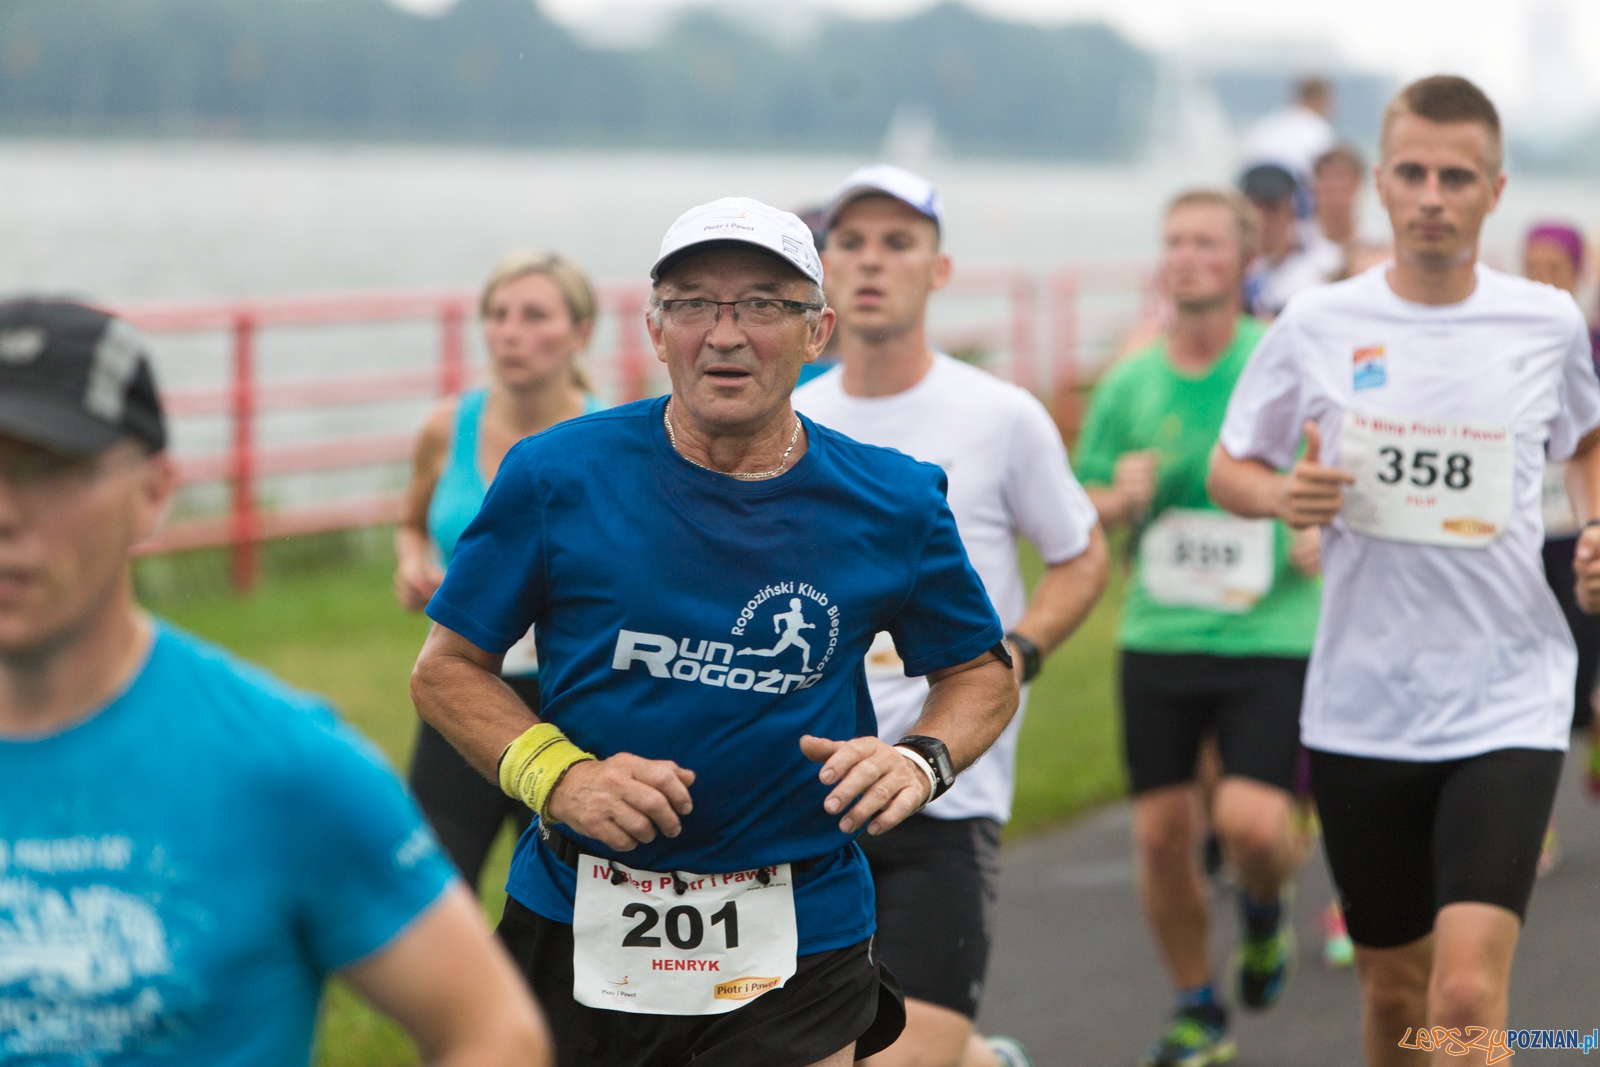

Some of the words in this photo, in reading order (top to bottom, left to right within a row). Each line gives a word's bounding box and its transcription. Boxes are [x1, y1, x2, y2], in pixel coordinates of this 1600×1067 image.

[1377, 446, 1472, 490] 358
[731, 581, 794, 636] Rogoziński
[798, 582, 828, 607] Klub
[817, 605, 840, 671] Biegacza
[593, 865, 612, 880] IV
[660, 876, 705, 892] Ptr
[711, 874, 717, 887] i
[621, 900, 739, 950] 201
[652, 959, 720, 971] HENRYK
[717, 985, 742, 995] Piotr
[745, 984, 749, 992] i
